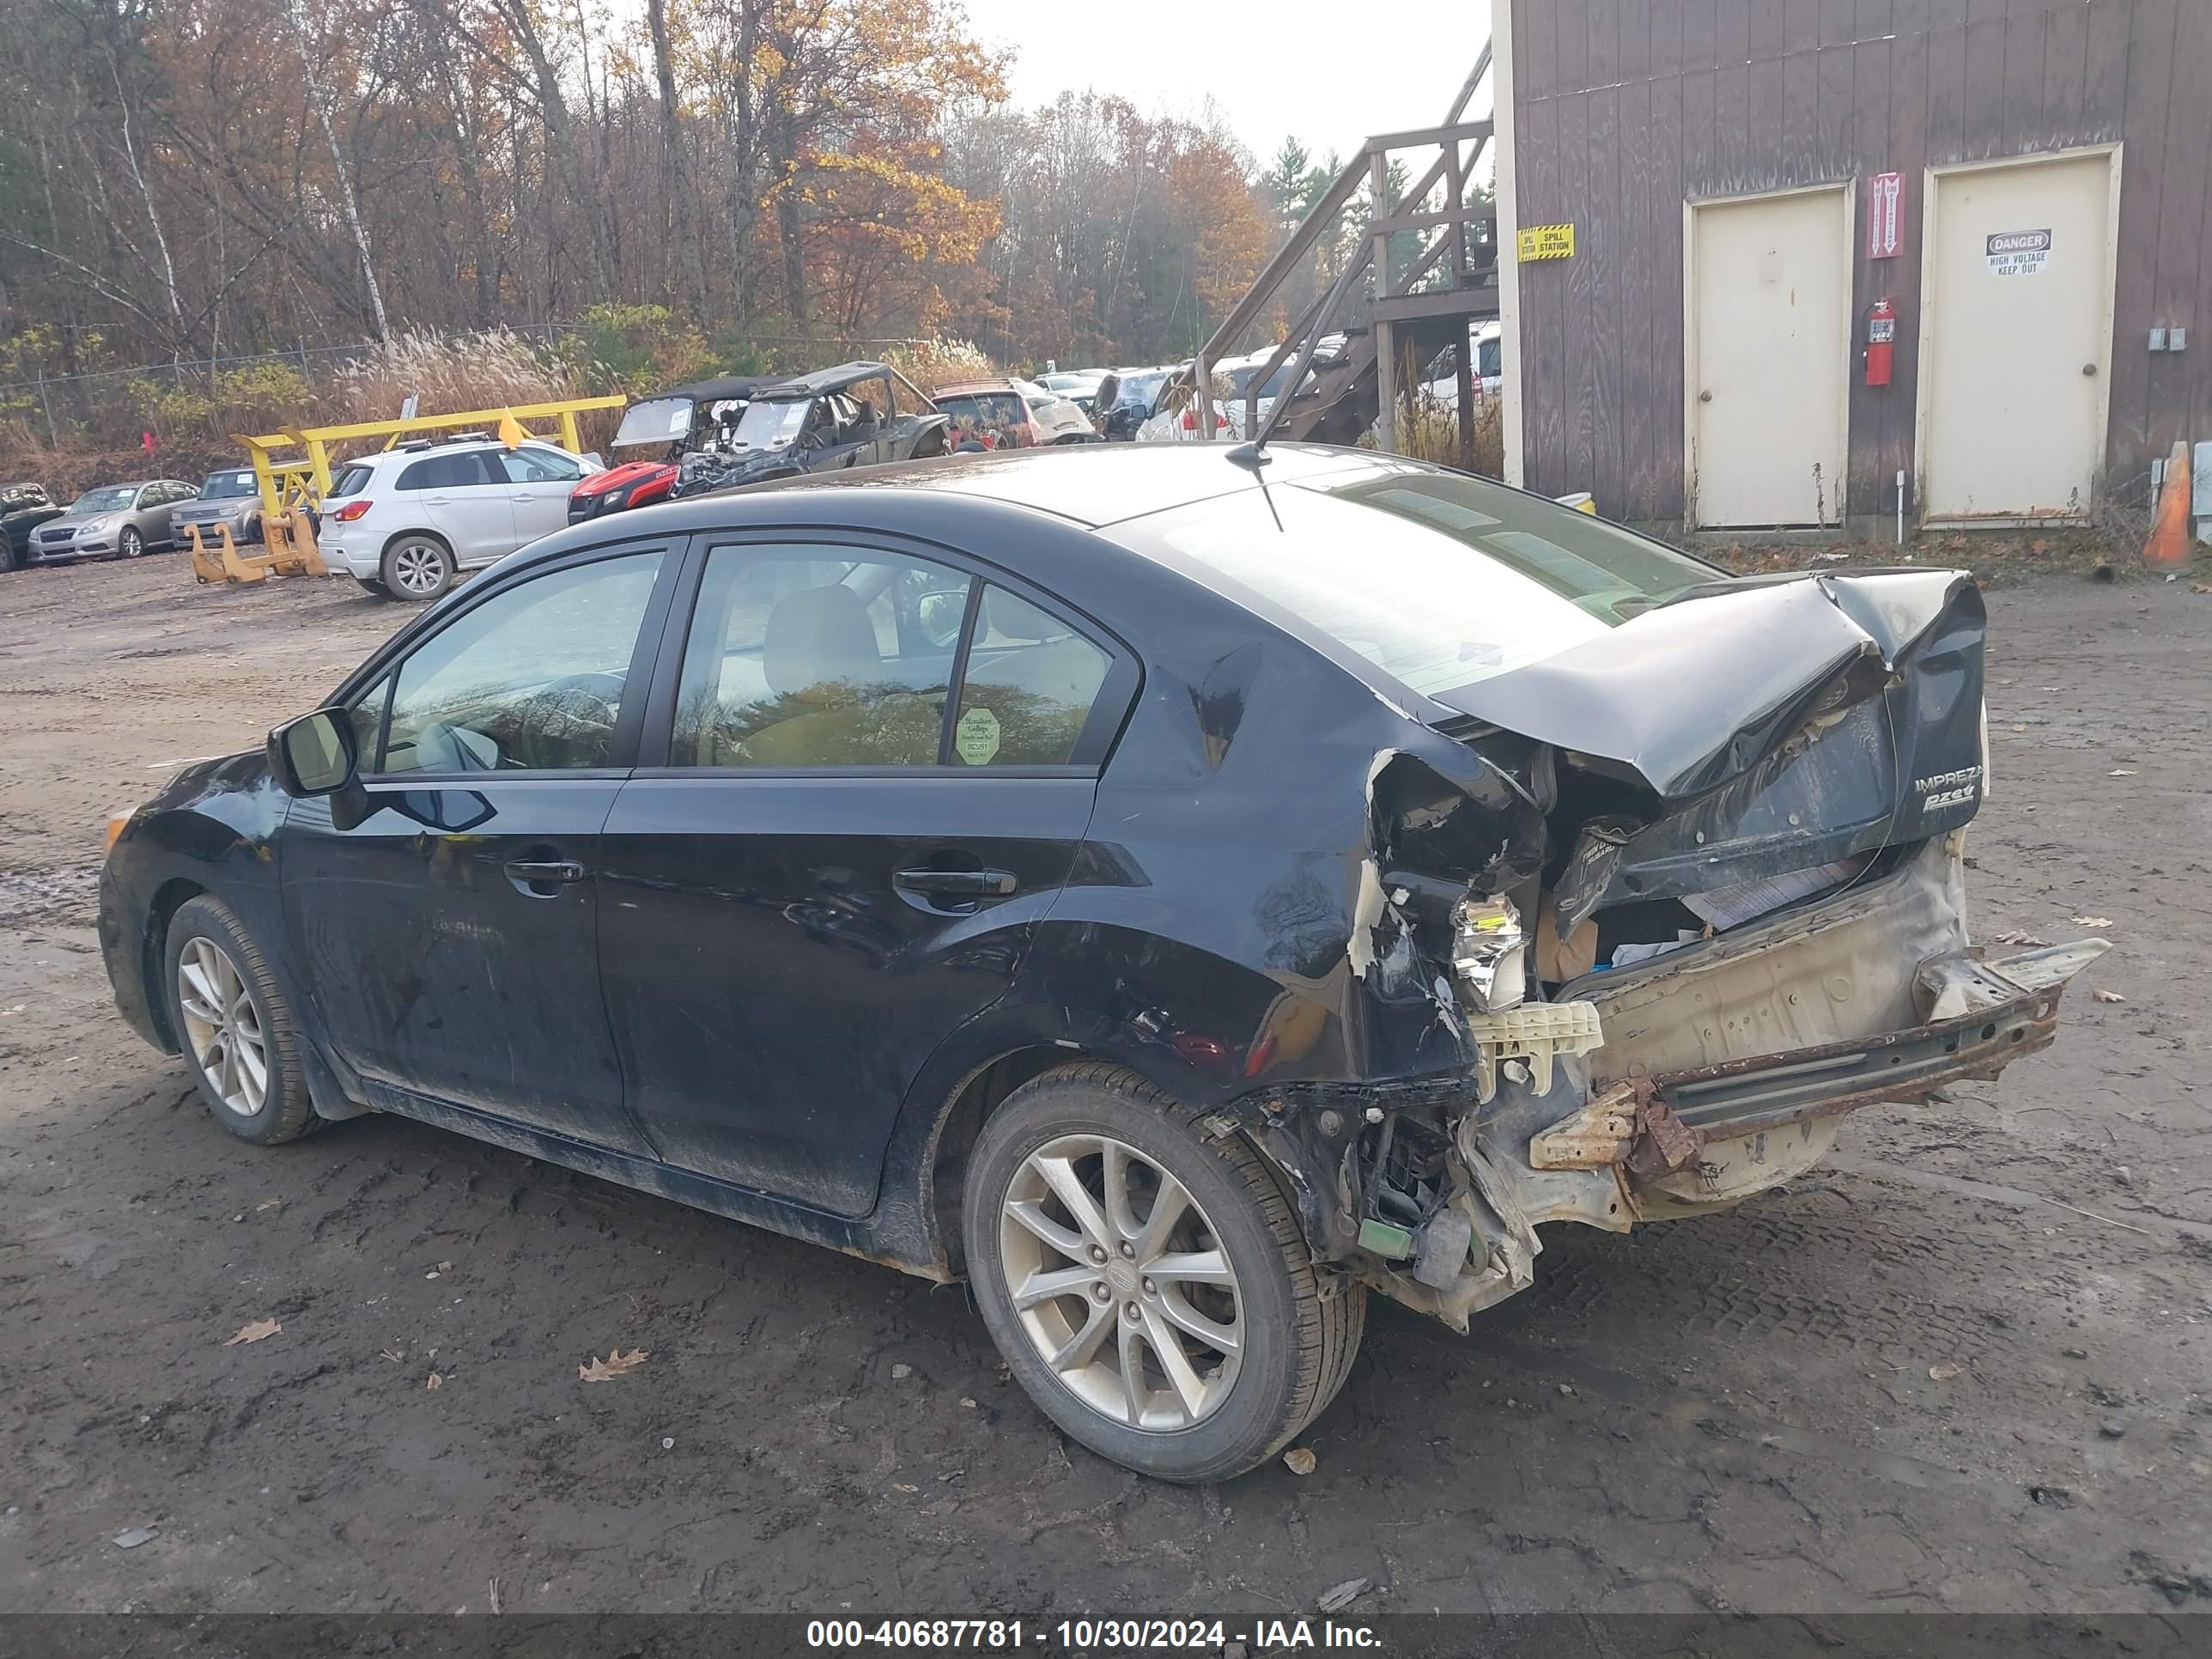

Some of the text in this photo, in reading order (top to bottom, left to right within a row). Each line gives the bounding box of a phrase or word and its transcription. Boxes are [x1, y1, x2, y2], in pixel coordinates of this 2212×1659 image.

[1544, 233, 1564, 241] SPILL
[1995, 235, 2043, 251] DANGER
[1540, 241, 1569, 252] STATION
[1990, 252, 2047, 266] HIGH VOLTAGE
[1998, 264, 2037, 276] KEEP OUT
[1915, 764, 1984, 792] IMPREZA
[1587, 844, 1615, 866] SUBARU
